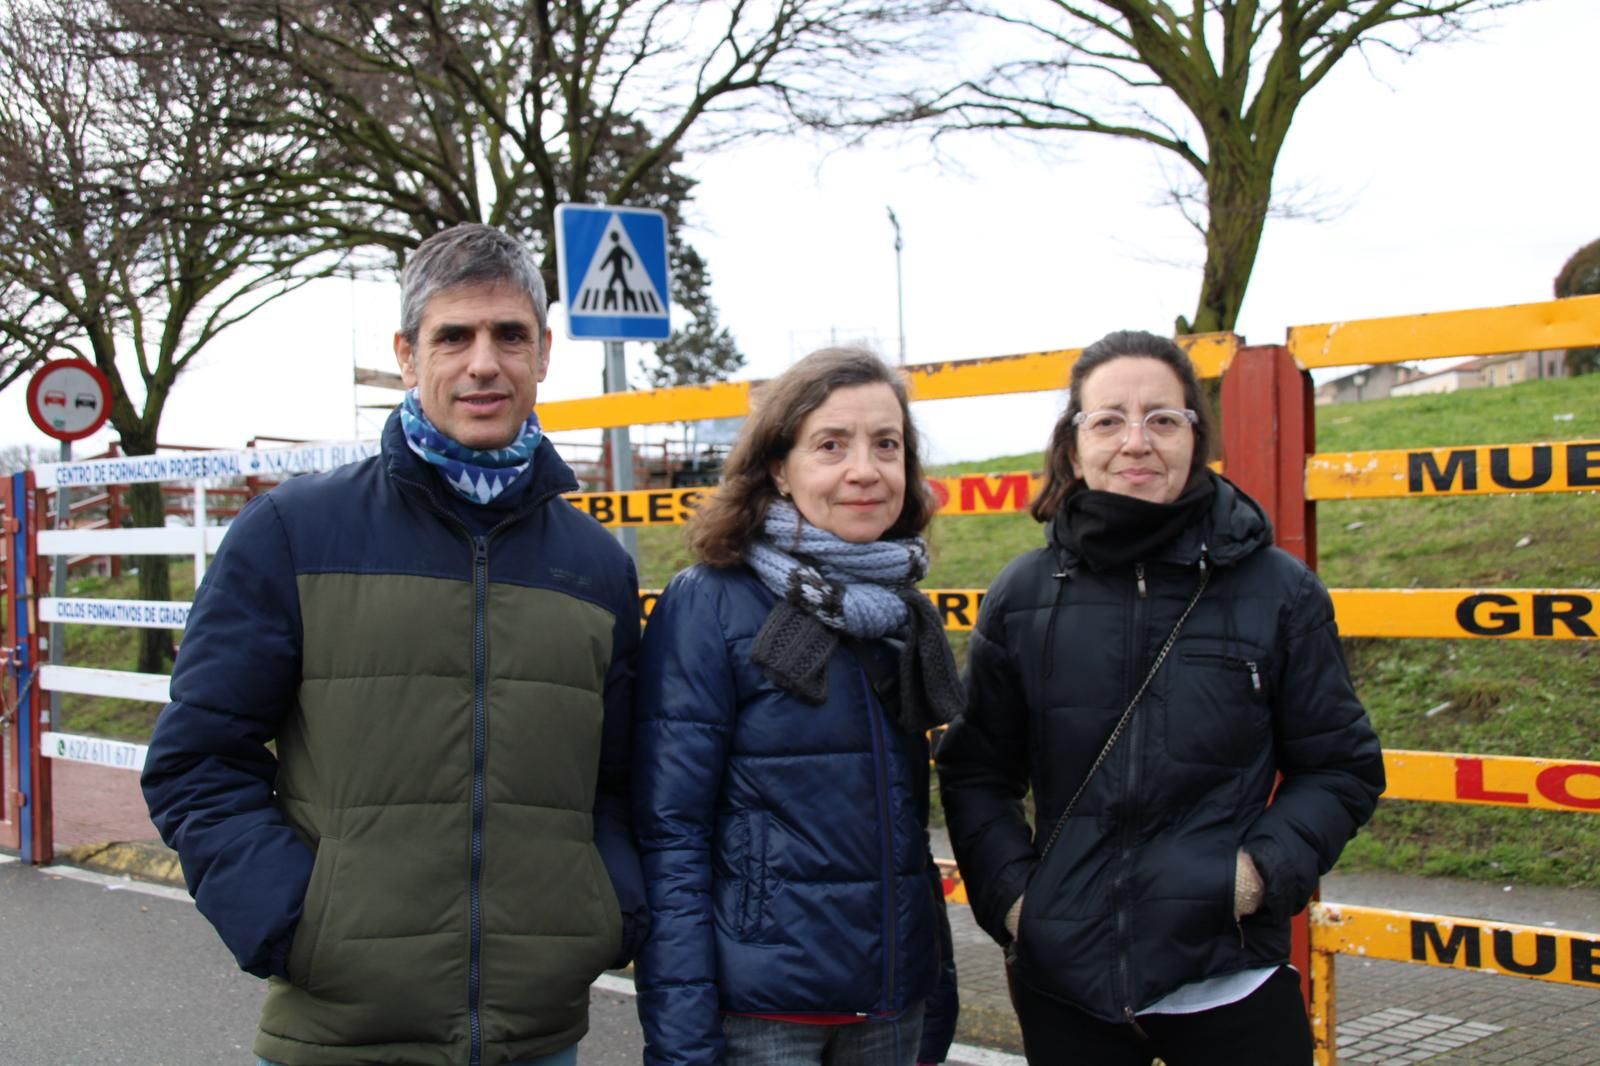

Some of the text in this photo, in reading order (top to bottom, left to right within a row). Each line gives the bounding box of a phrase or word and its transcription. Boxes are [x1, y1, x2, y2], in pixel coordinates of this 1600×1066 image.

[56, 466, 91, 484] CENTRO
[94, 464, 106, 482] DE
[170, 455, 241, 477] PROFESIONAL
[57, 602, 86, 618] CICLOS
[88, 603, 142, 622] FORMATIVOS
[144, 606, 156, 622] DE
